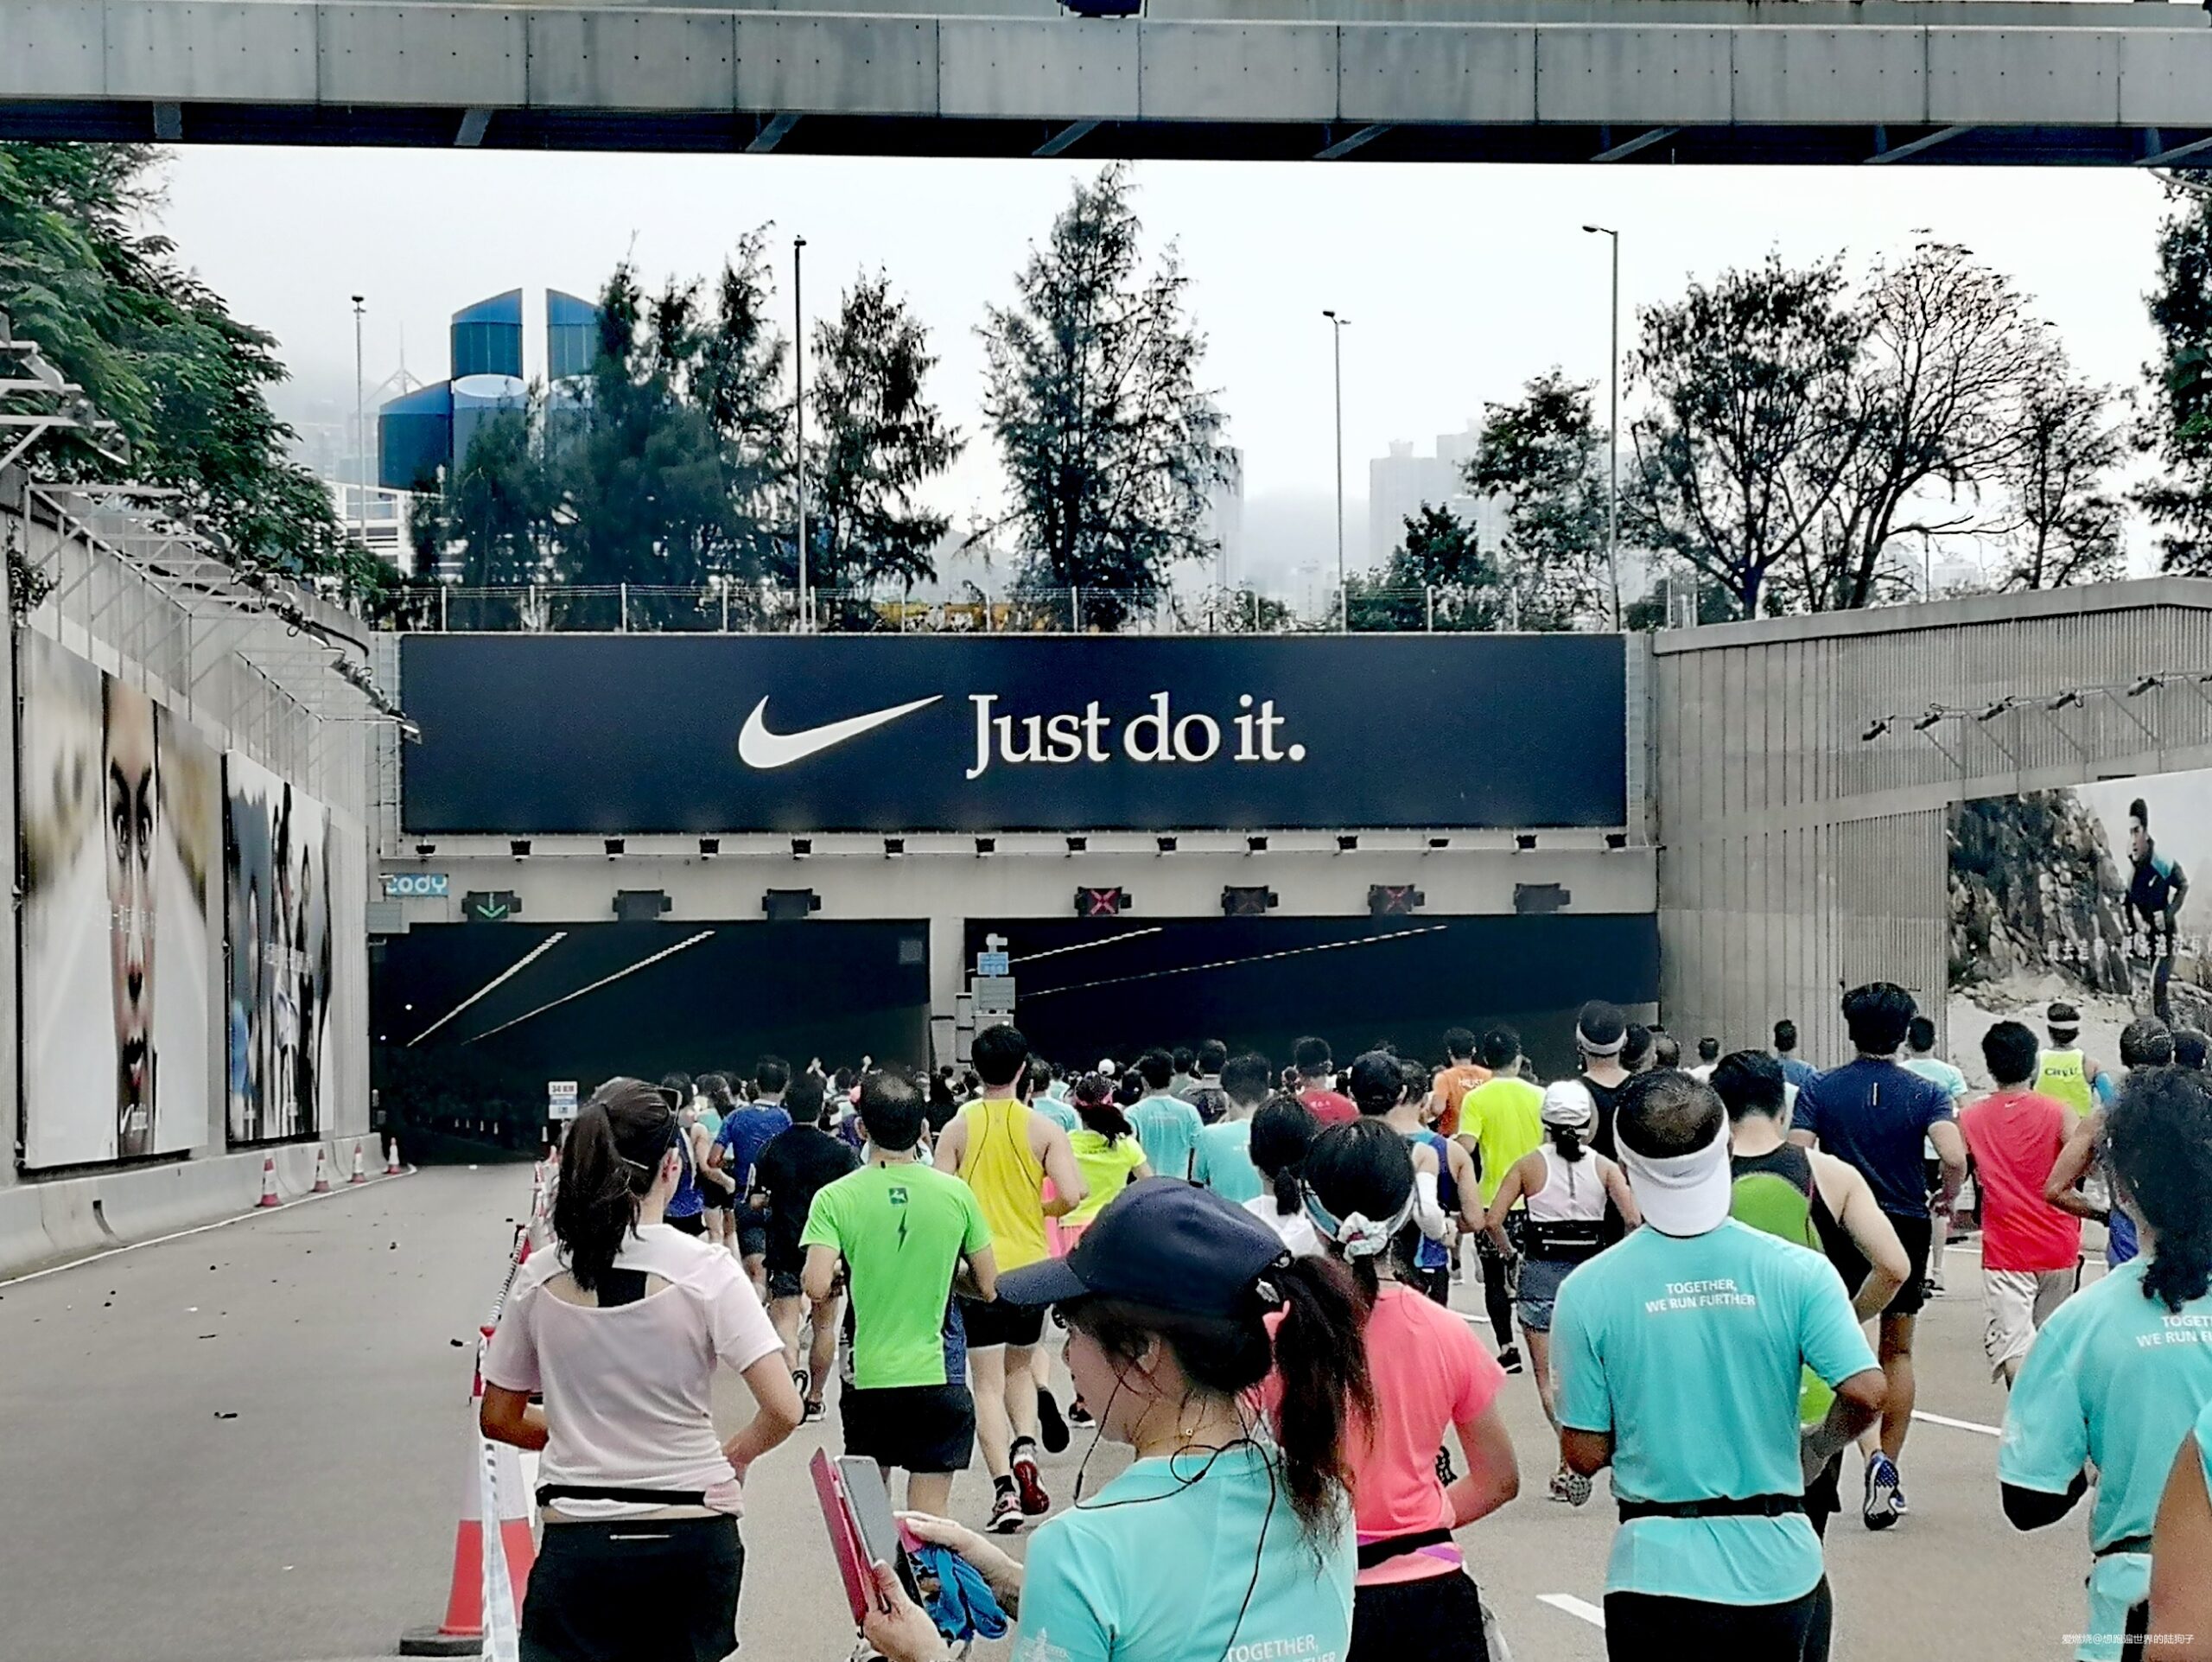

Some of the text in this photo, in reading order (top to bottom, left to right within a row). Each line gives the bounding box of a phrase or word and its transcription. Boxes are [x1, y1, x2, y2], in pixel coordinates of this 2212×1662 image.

[966, 691, 1306, 780] Just do it.
[1665, 1278, 1738, 1295] TOGETHER,
[1645, 1293, 1756, 1313] WE RUN FURTHER
[2162, 1315, 2212, 1328] TOGET
[2135, 1333, 2162, 1347] WE
[2165, 1330, 2197, 1343] RUN
